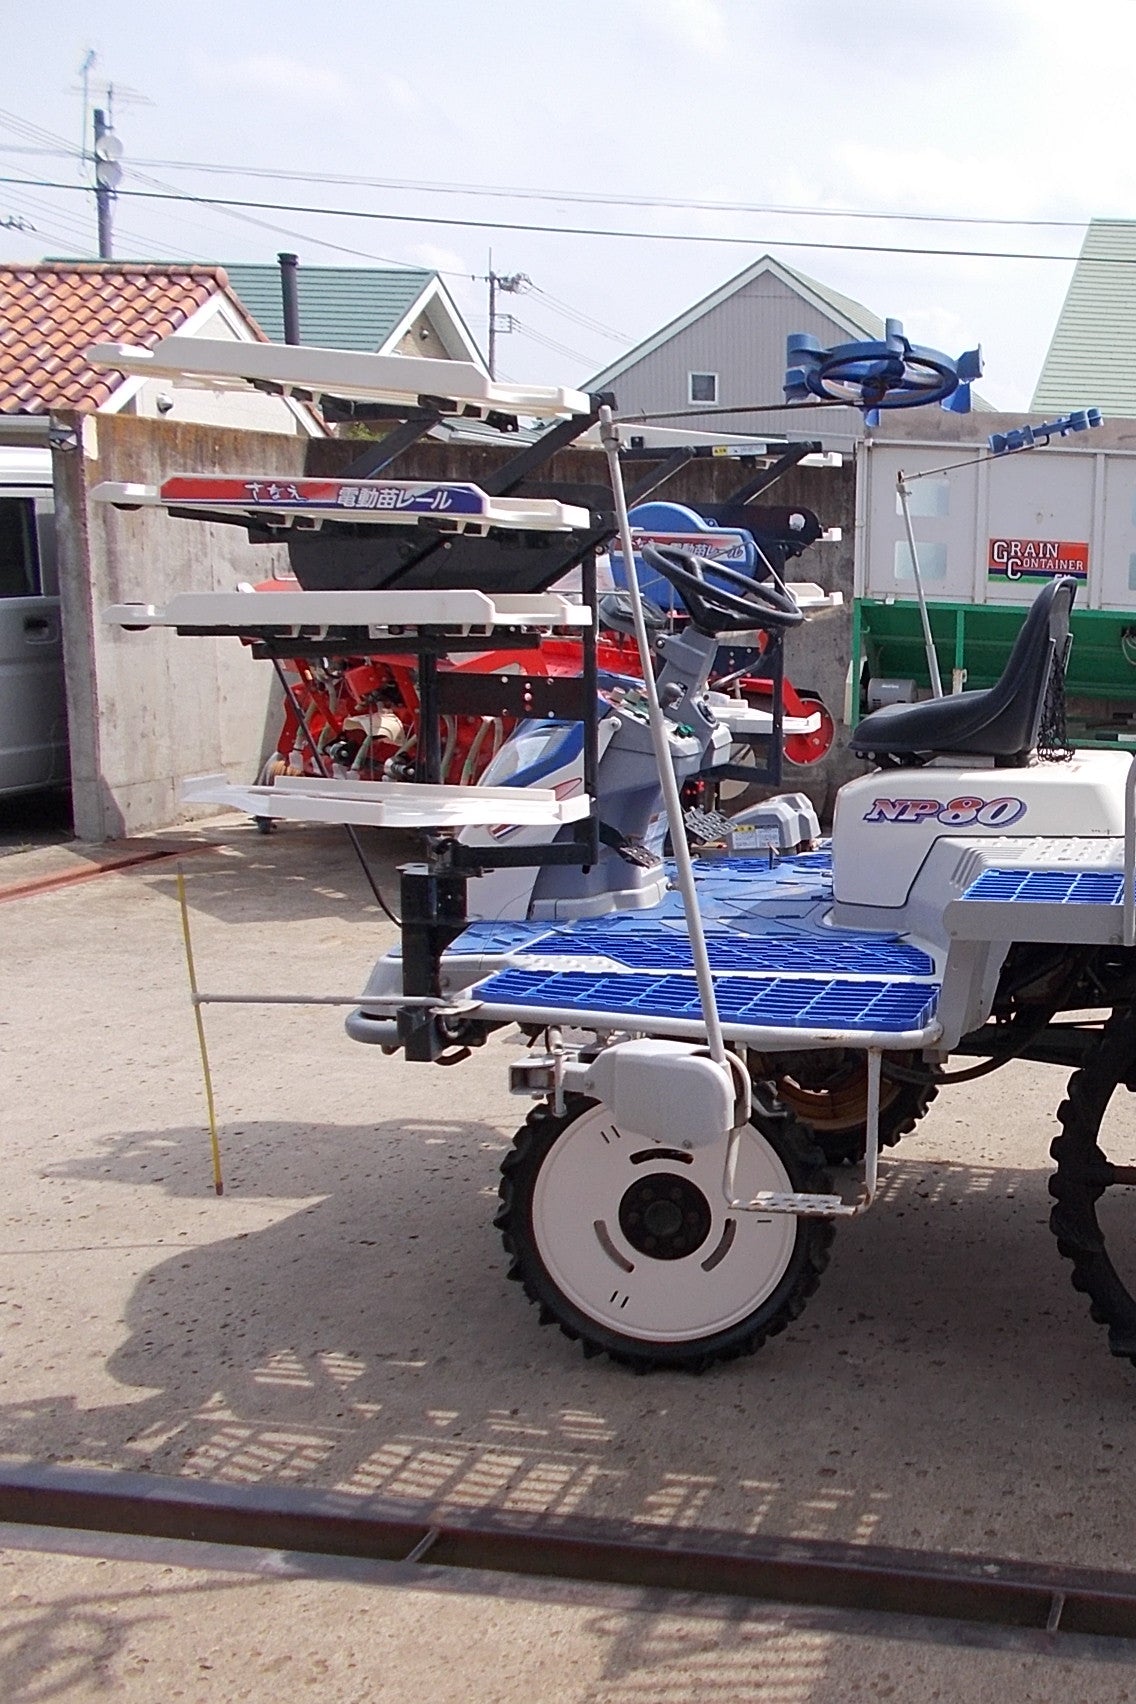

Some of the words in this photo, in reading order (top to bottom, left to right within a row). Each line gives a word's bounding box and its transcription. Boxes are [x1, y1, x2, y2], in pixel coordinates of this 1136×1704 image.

[244, 482, 307, 502] さなえ
[338, 486, 452, 510] 電動苗レール
[993, 540, 1059, 563] GRAIN
[1007, 558, 1084, 580] CONTAINER
